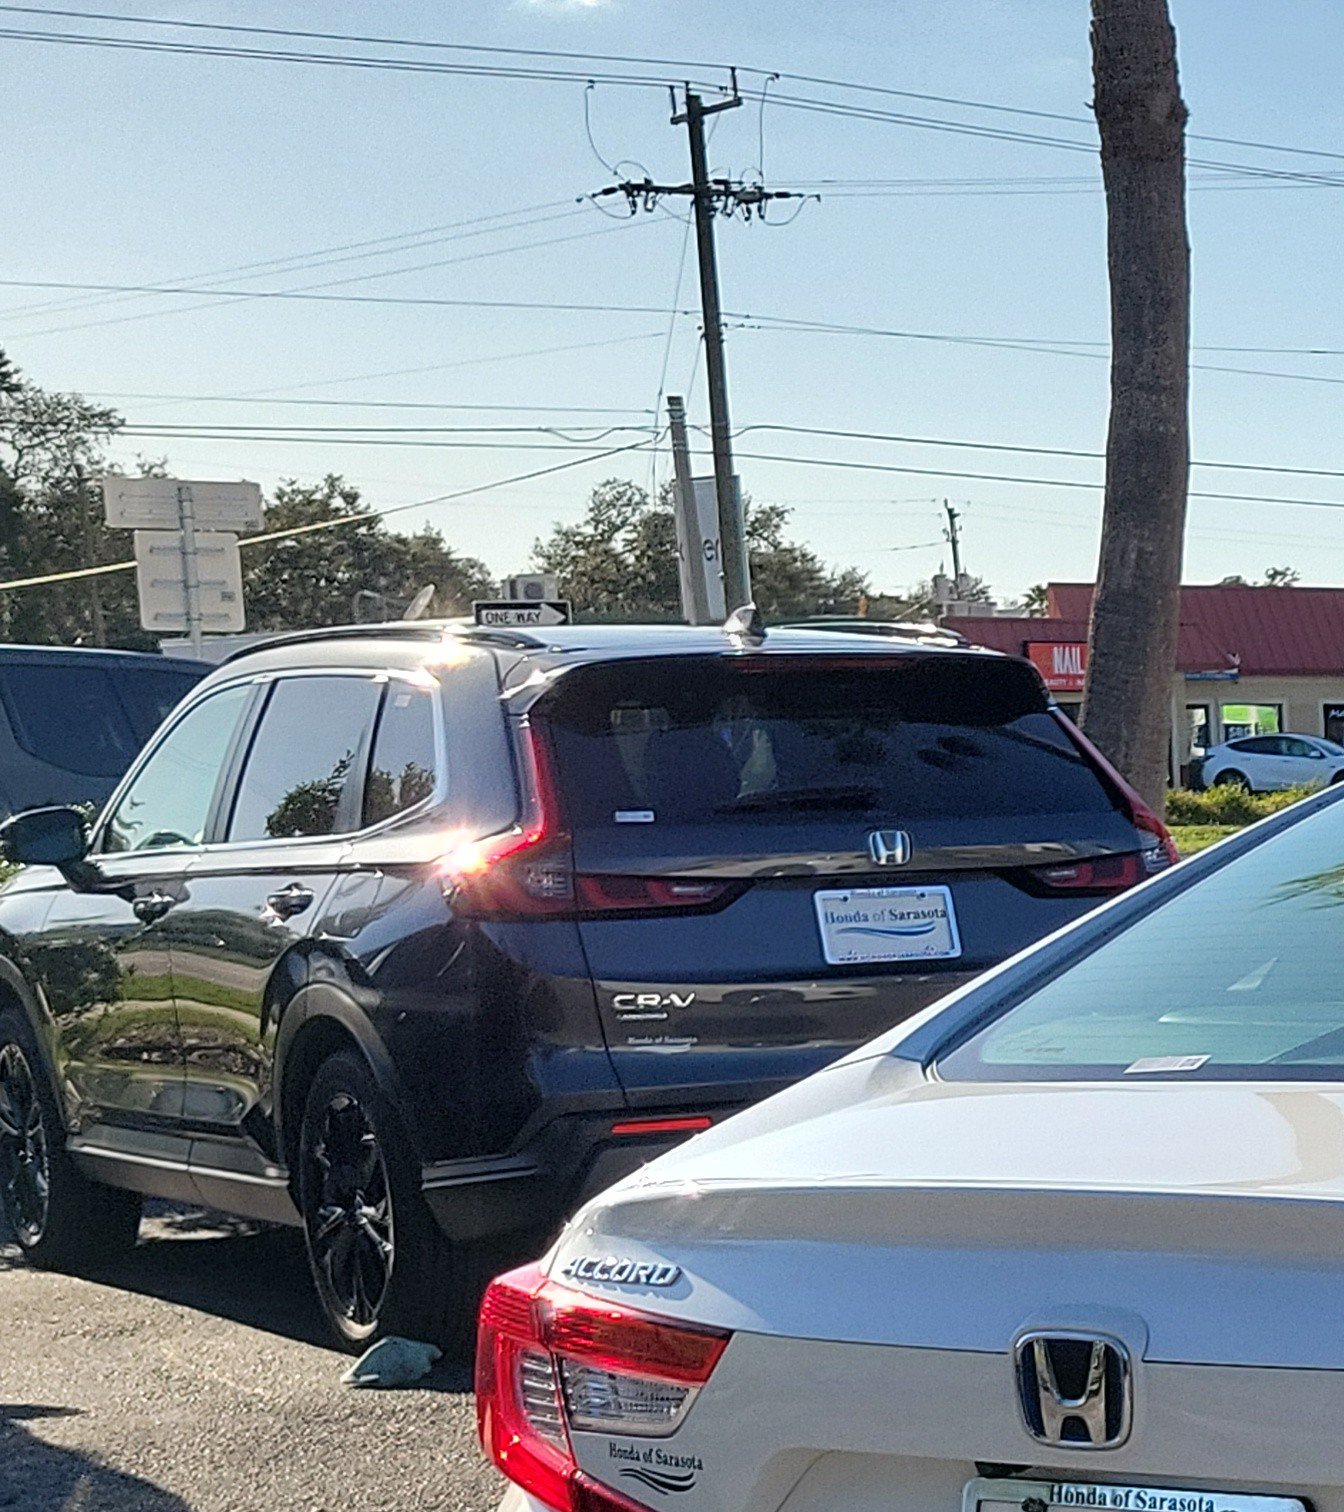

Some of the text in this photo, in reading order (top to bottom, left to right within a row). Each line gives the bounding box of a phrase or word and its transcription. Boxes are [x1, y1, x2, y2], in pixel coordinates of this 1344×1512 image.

[485, 610, 542, 625] ONE WAY
[825, 907, 947, 924] Honda of Sarasota
[613, 992, 696, 1010] CR-V
[563, 1255, 682, 1288] ACCORD
[609, 1442, 704, 1471] Honda of Sarasota
[1049, 1484, 1107, 1508] Honda
[1113, 1489, 1134, 1508] of
